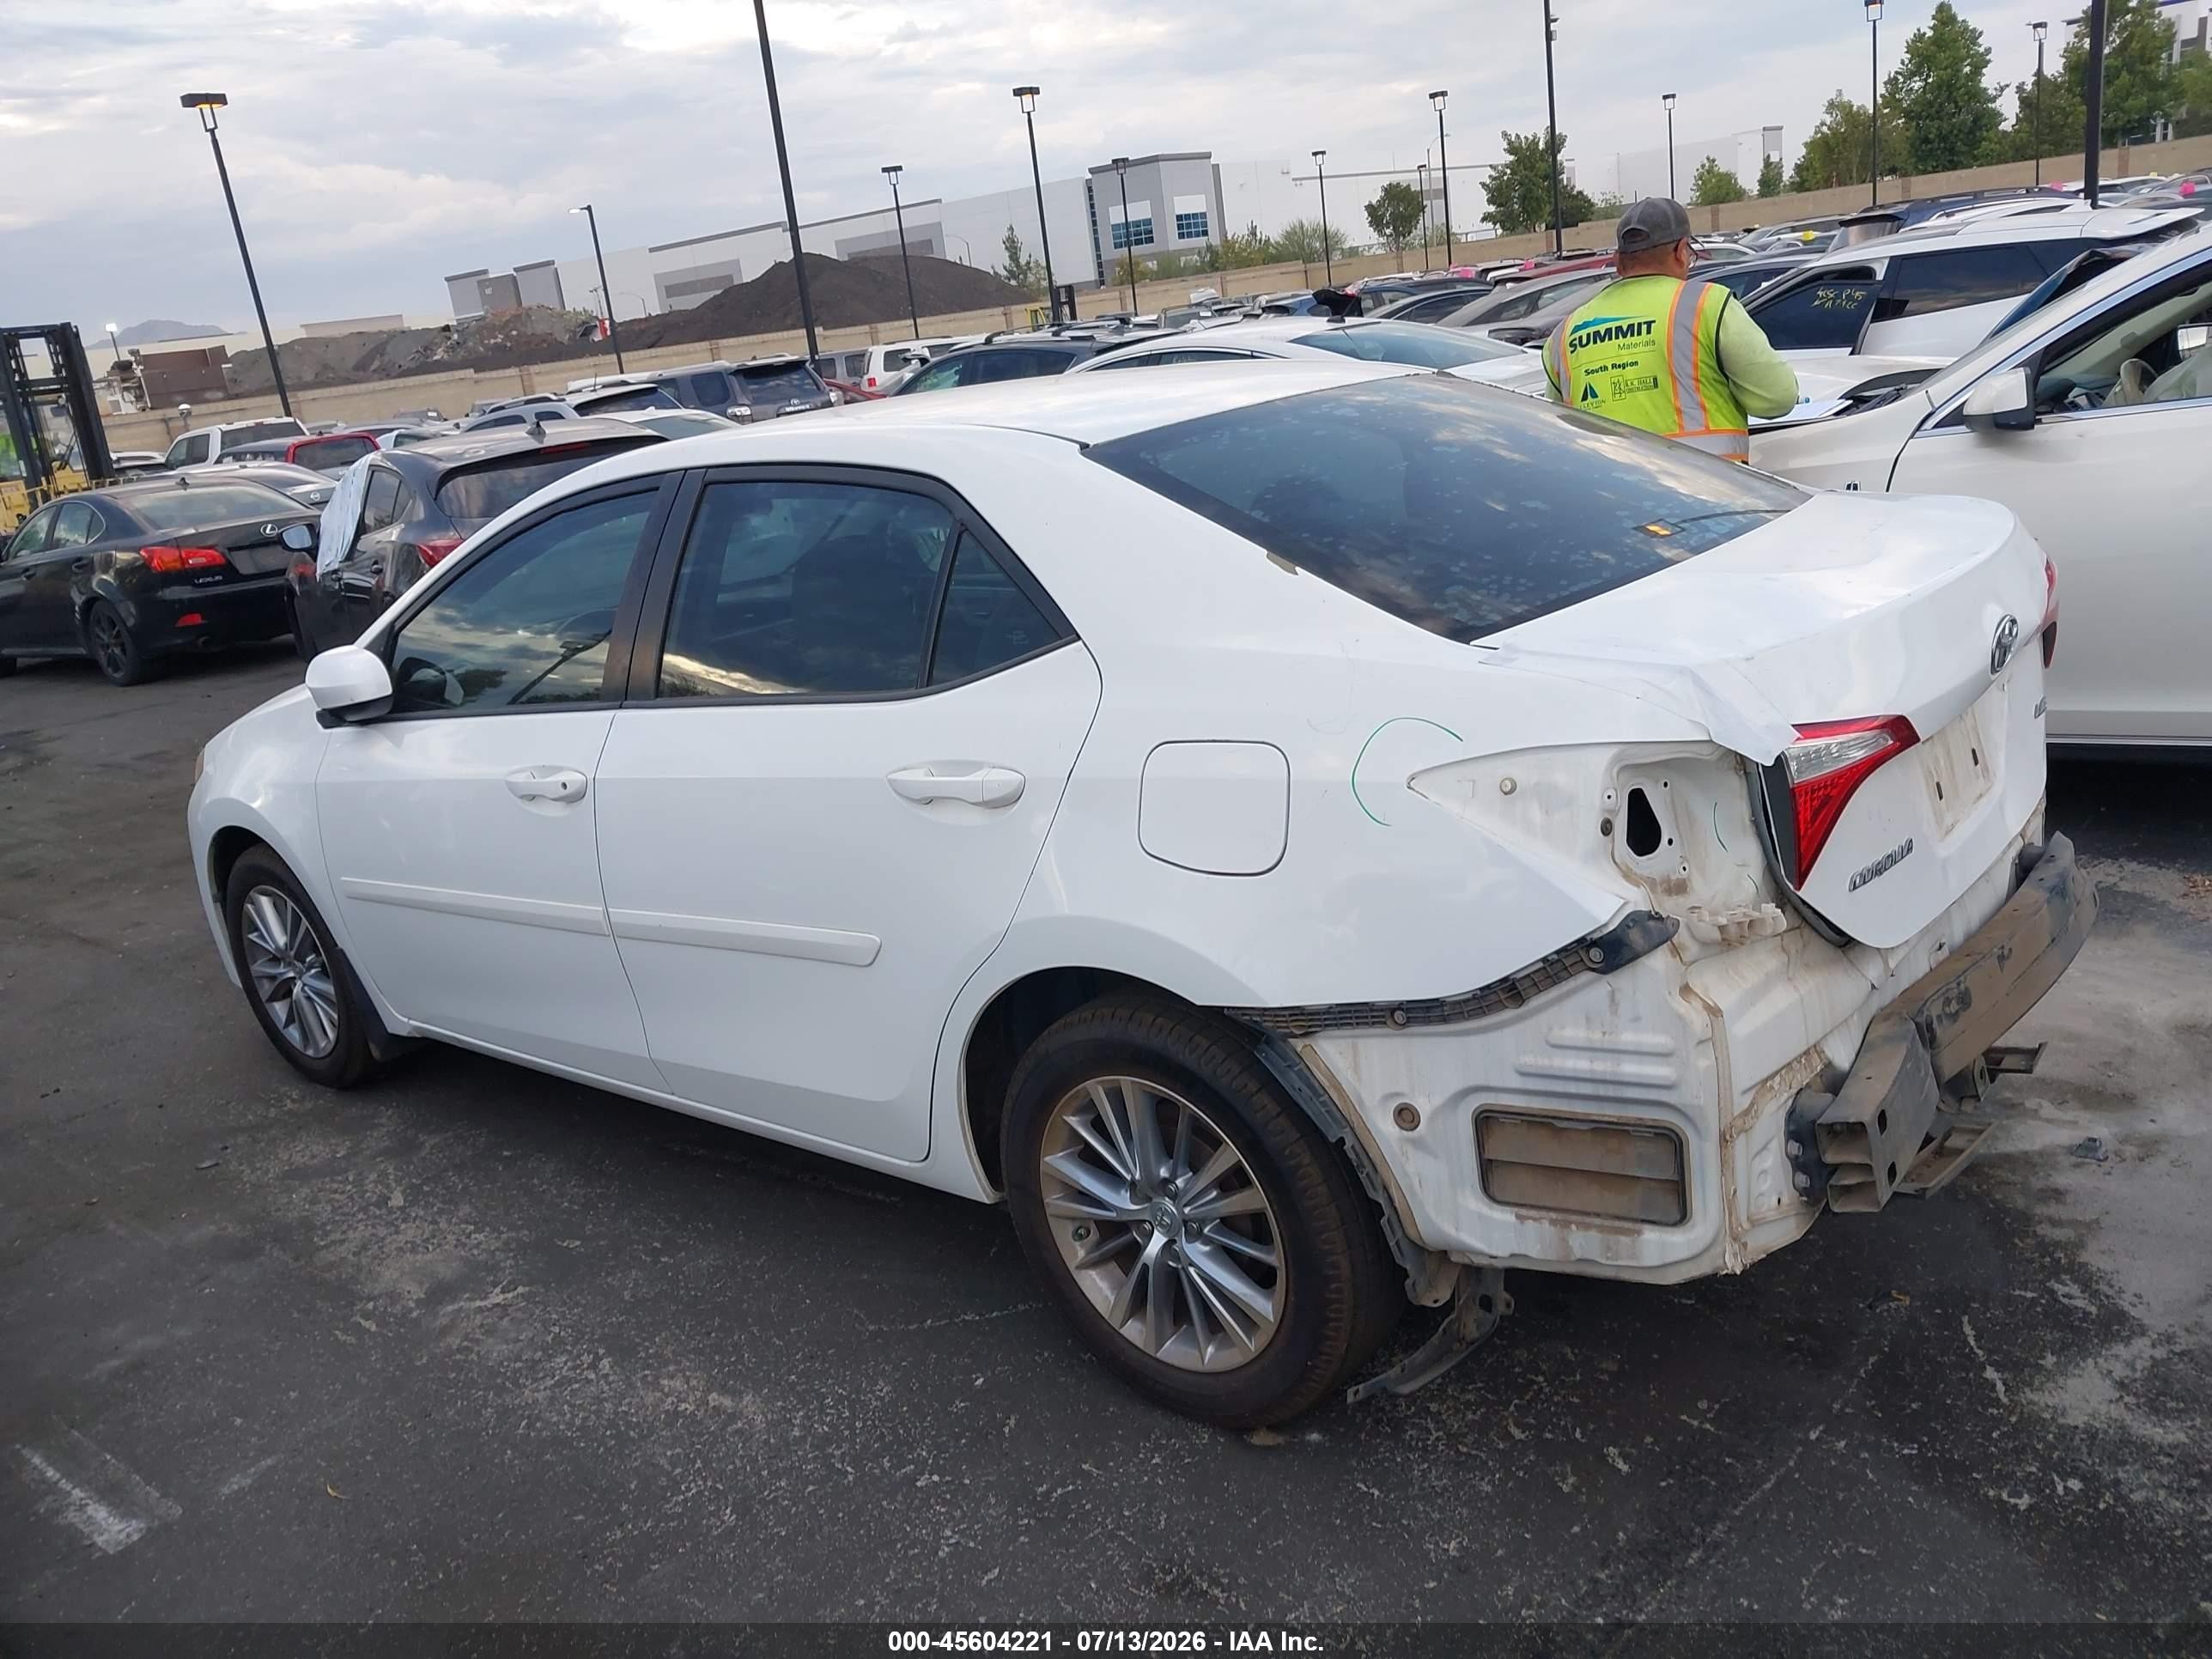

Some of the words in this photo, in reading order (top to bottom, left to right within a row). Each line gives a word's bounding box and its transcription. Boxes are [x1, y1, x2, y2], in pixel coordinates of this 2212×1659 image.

[1569, 319, 1656, 355] SUMMIT
[1617, 338, 1656, 352] Materials
[1584, 366, 1609, 377] South
[1611, 359, 1639, 372] Region
[1848, 837, 1914, 893] COROLLA
